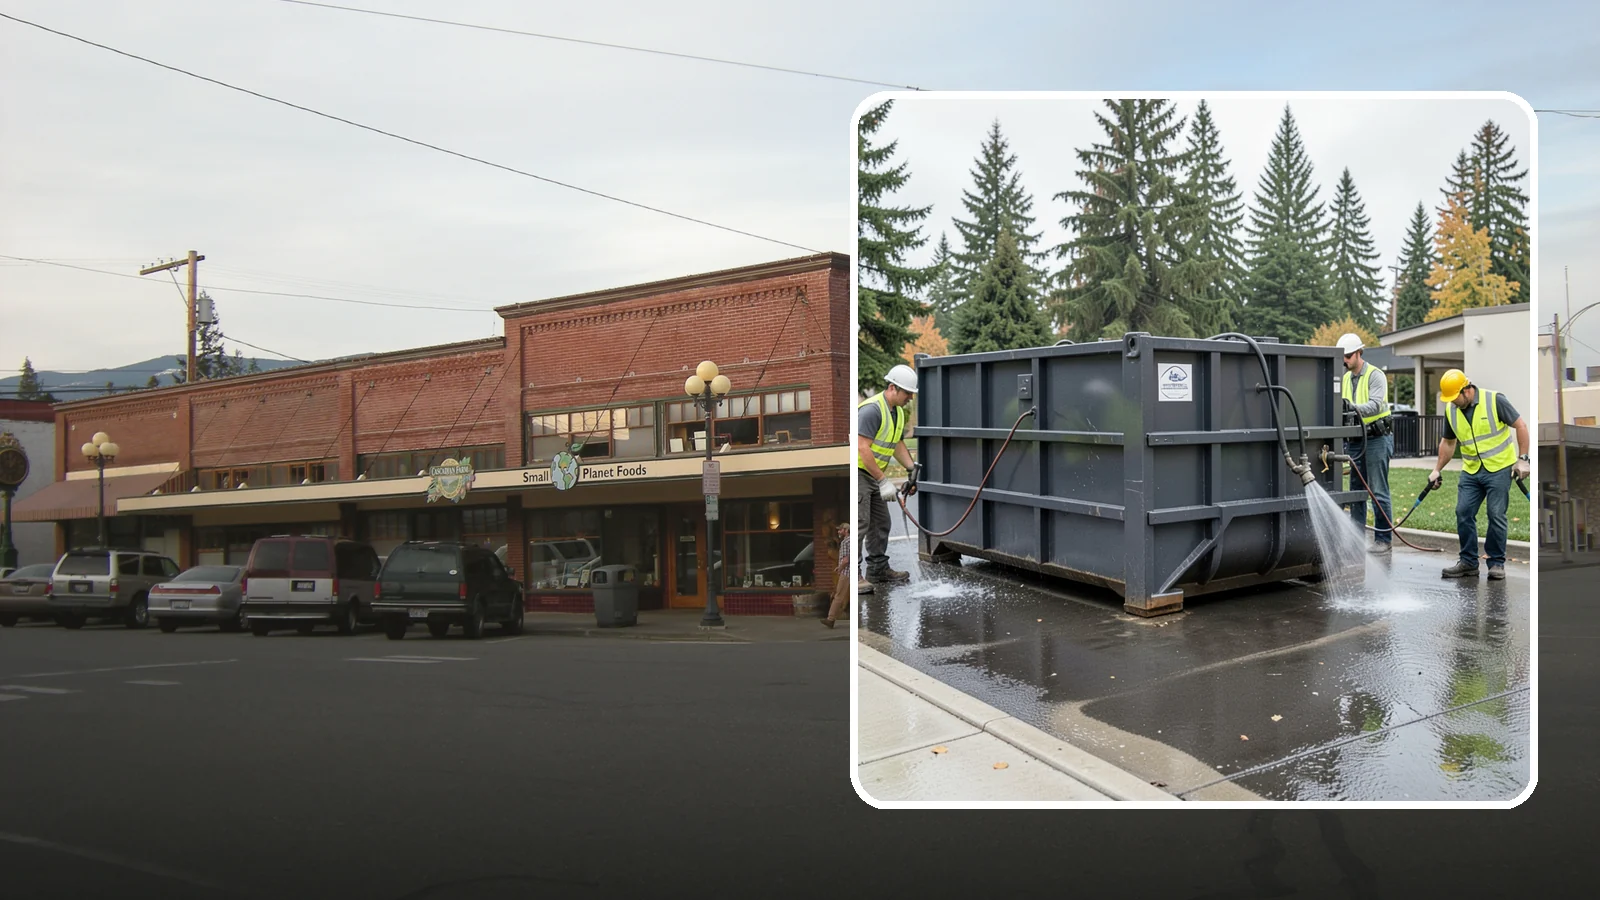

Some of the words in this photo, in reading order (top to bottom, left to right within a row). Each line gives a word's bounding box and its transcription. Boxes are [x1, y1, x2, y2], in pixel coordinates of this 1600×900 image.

[523, 471, 549, 483] Small
[582, 467, 614, 479] Planet
[616, 463, 647, 476] Foods
